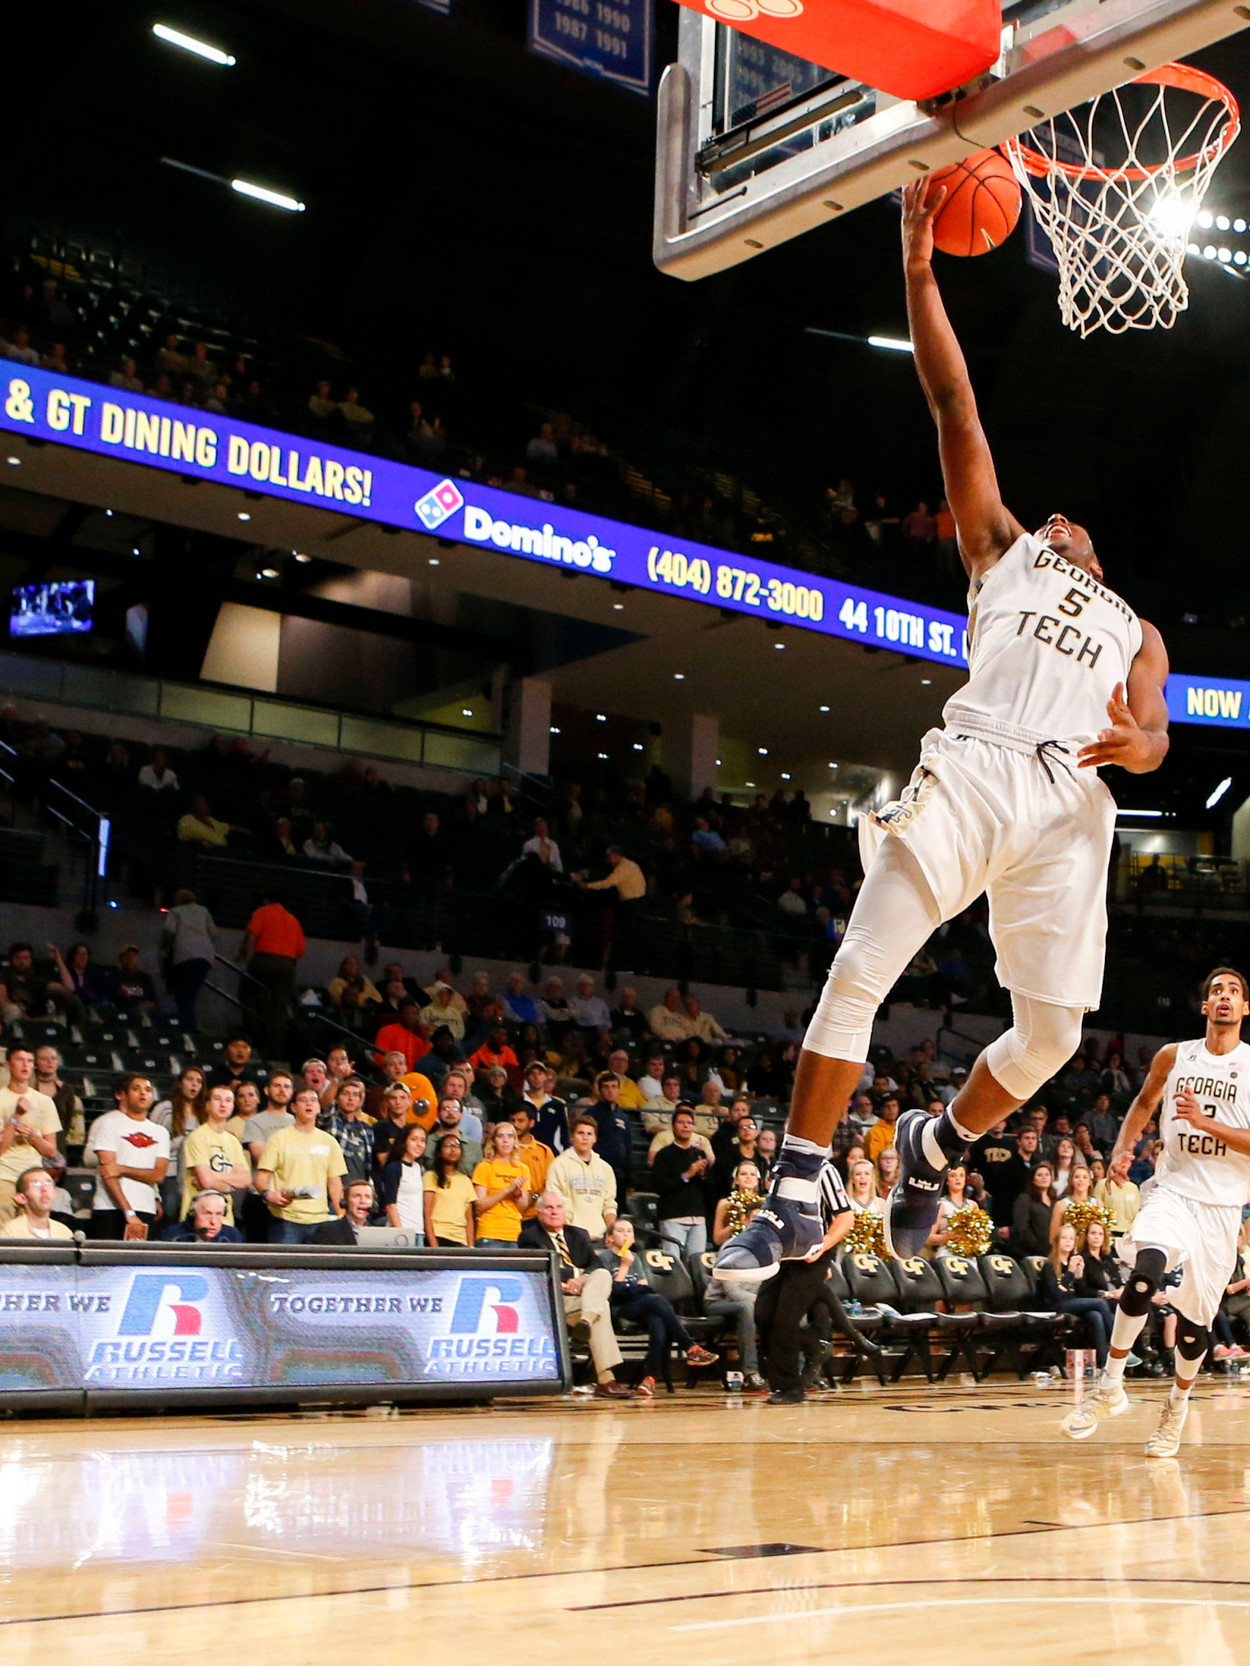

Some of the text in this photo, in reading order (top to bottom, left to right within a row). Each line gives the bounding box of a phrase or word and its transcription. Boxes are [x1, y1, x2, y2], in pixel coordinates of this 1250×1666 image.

[5, 378, 373, 507] & GT DINING DOLLARS!
[464, 505, 616, 574] Domino's
[1034, 549, 1132, 623] GEORGIA
[646, 545, 711, 595] (404)
[716, 565, 823, 622] 872-3000
[838, 598, 868, 633] 44
[874, 607, 924, 650] 10TH
[929, 621, 957, 657] ST.
[1058, 588, 1091, 618] 5
[1017, 610, 1103, 669] TECH
[1187, 687, 1243, 718] NOW
[546, 915, 566, 928] 109
[1178, 1133, 1226, 1156] TECH
[0, 1294, 112, 1313] HER WE
[271, 1294, 443, 1314] TOGETHER WE
[90, 1340, 243, 1363] RUSSELL
[428, 1337, 555, 1358] RUSSELL
[85, 1363, 243, 1380] ATHLETIC
[425, 1360, 555, 1374] ATHLETIC
